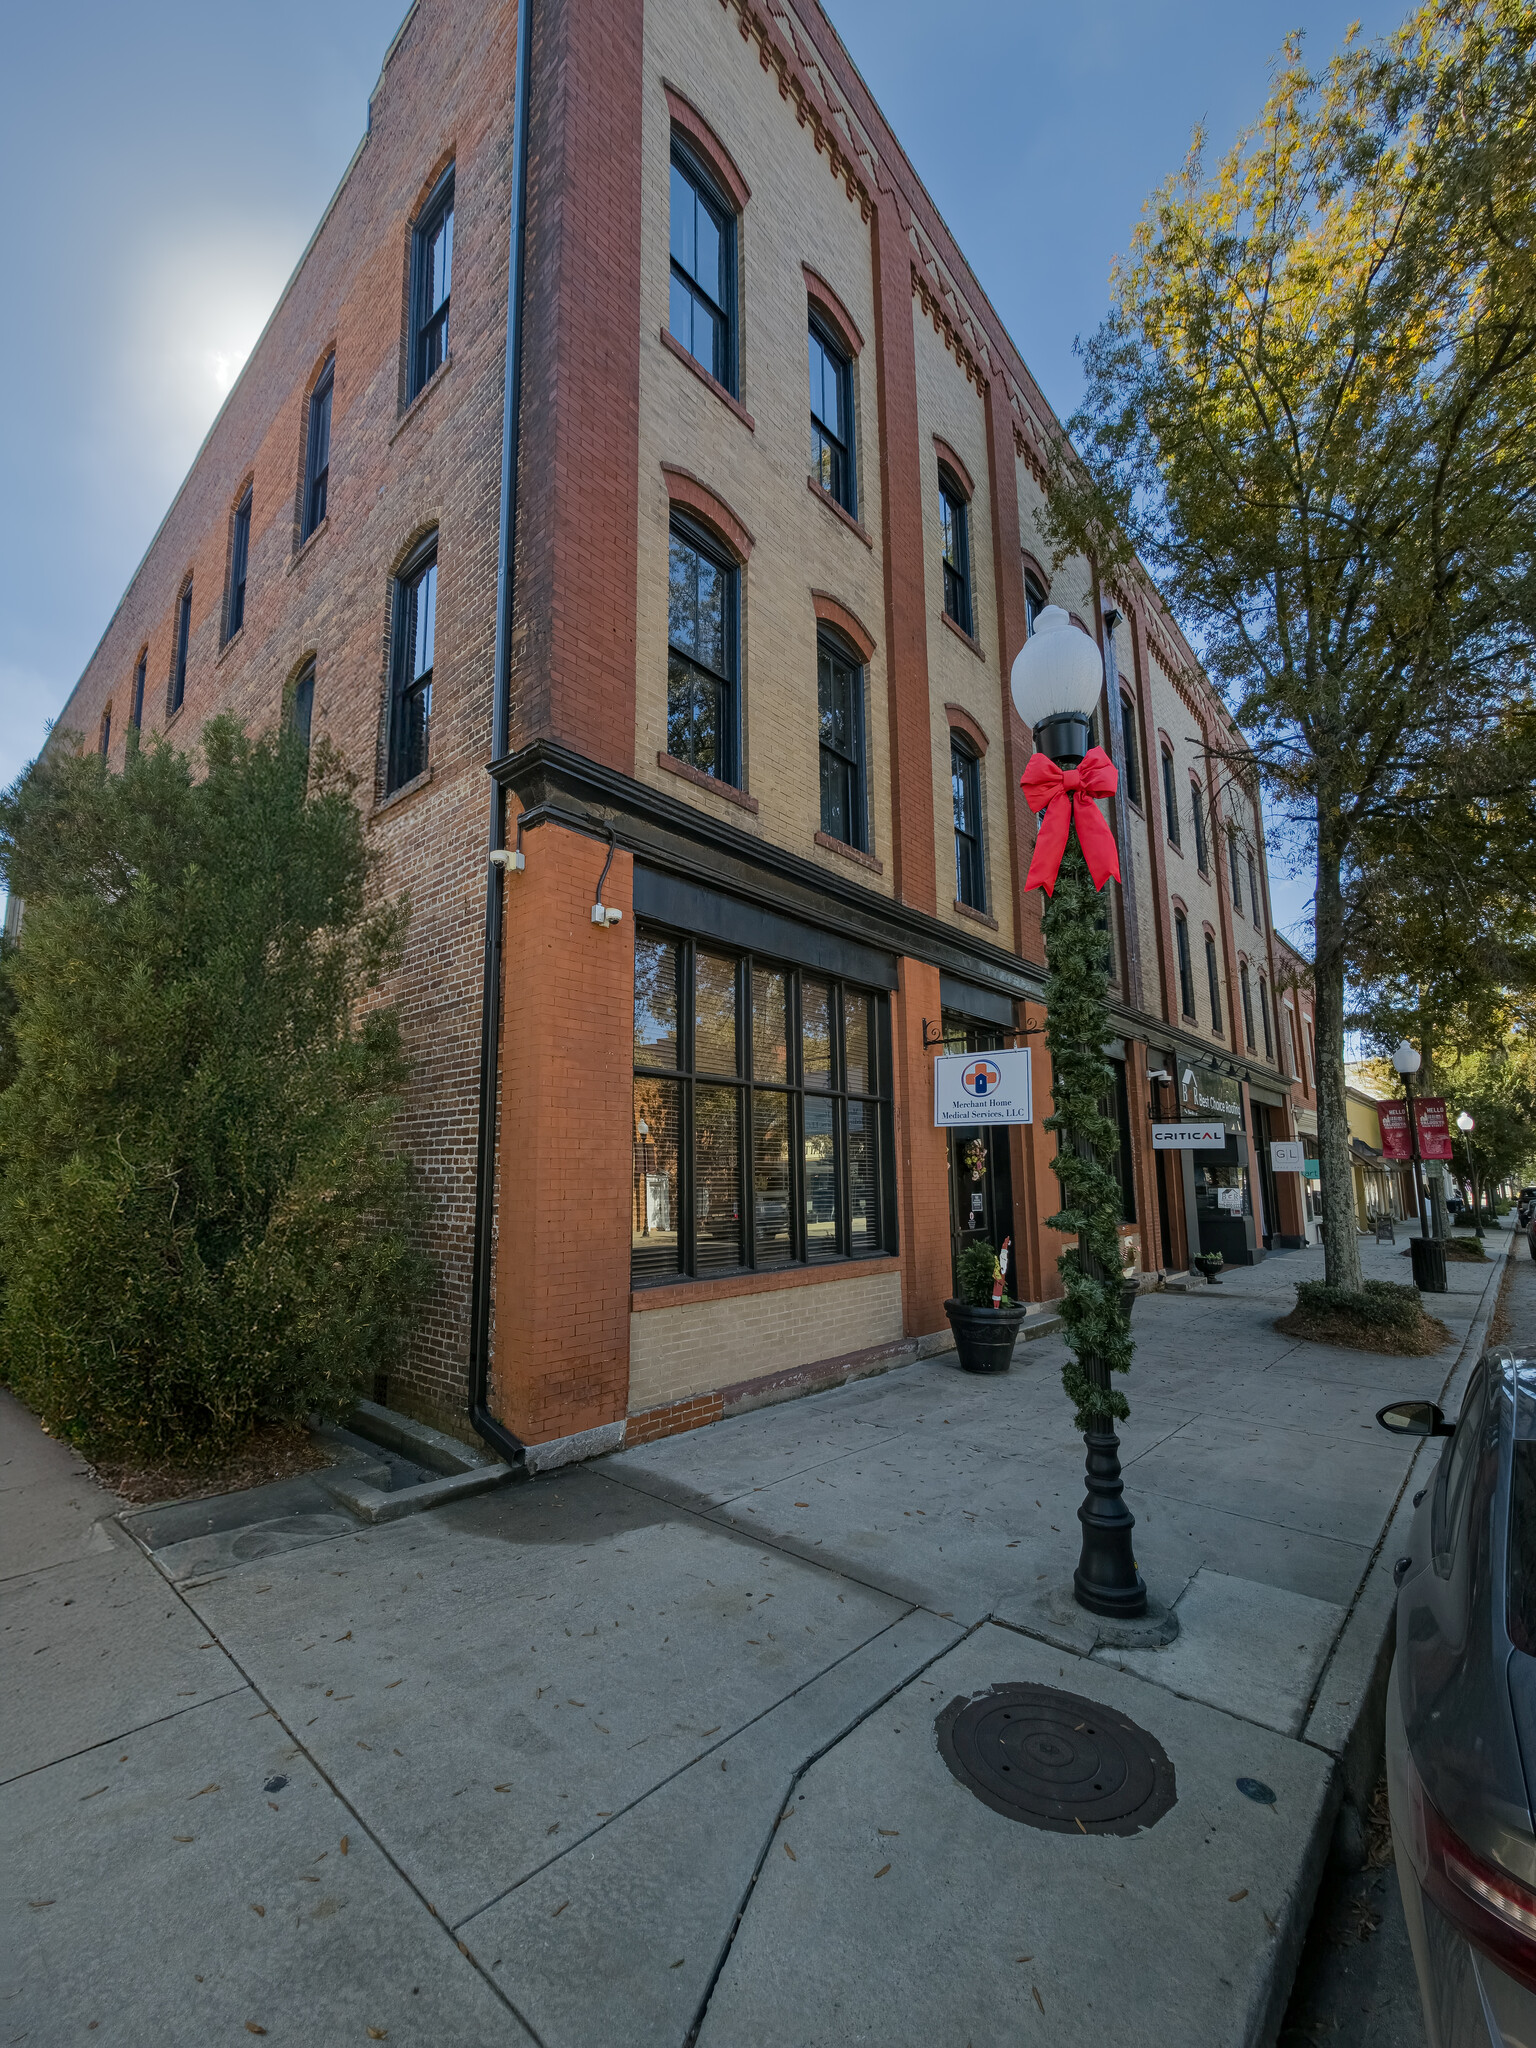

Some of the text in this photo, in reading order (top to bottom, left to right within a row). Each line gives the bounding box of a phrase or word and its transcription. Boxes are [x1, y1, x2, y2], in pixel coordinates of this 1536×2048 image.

[952, 1099, 1012, 1108] Merchant Home
[1199, 1093, 1210, 1109] Best
[1210, 1096, 1225, 1113] Choice
[1225, 1100, 1240, 1119] Roofing
[942, 1108, 1024, 1119] Medical Services, LLC
[1155, 1132, 1221, 1140] CRITICAL
